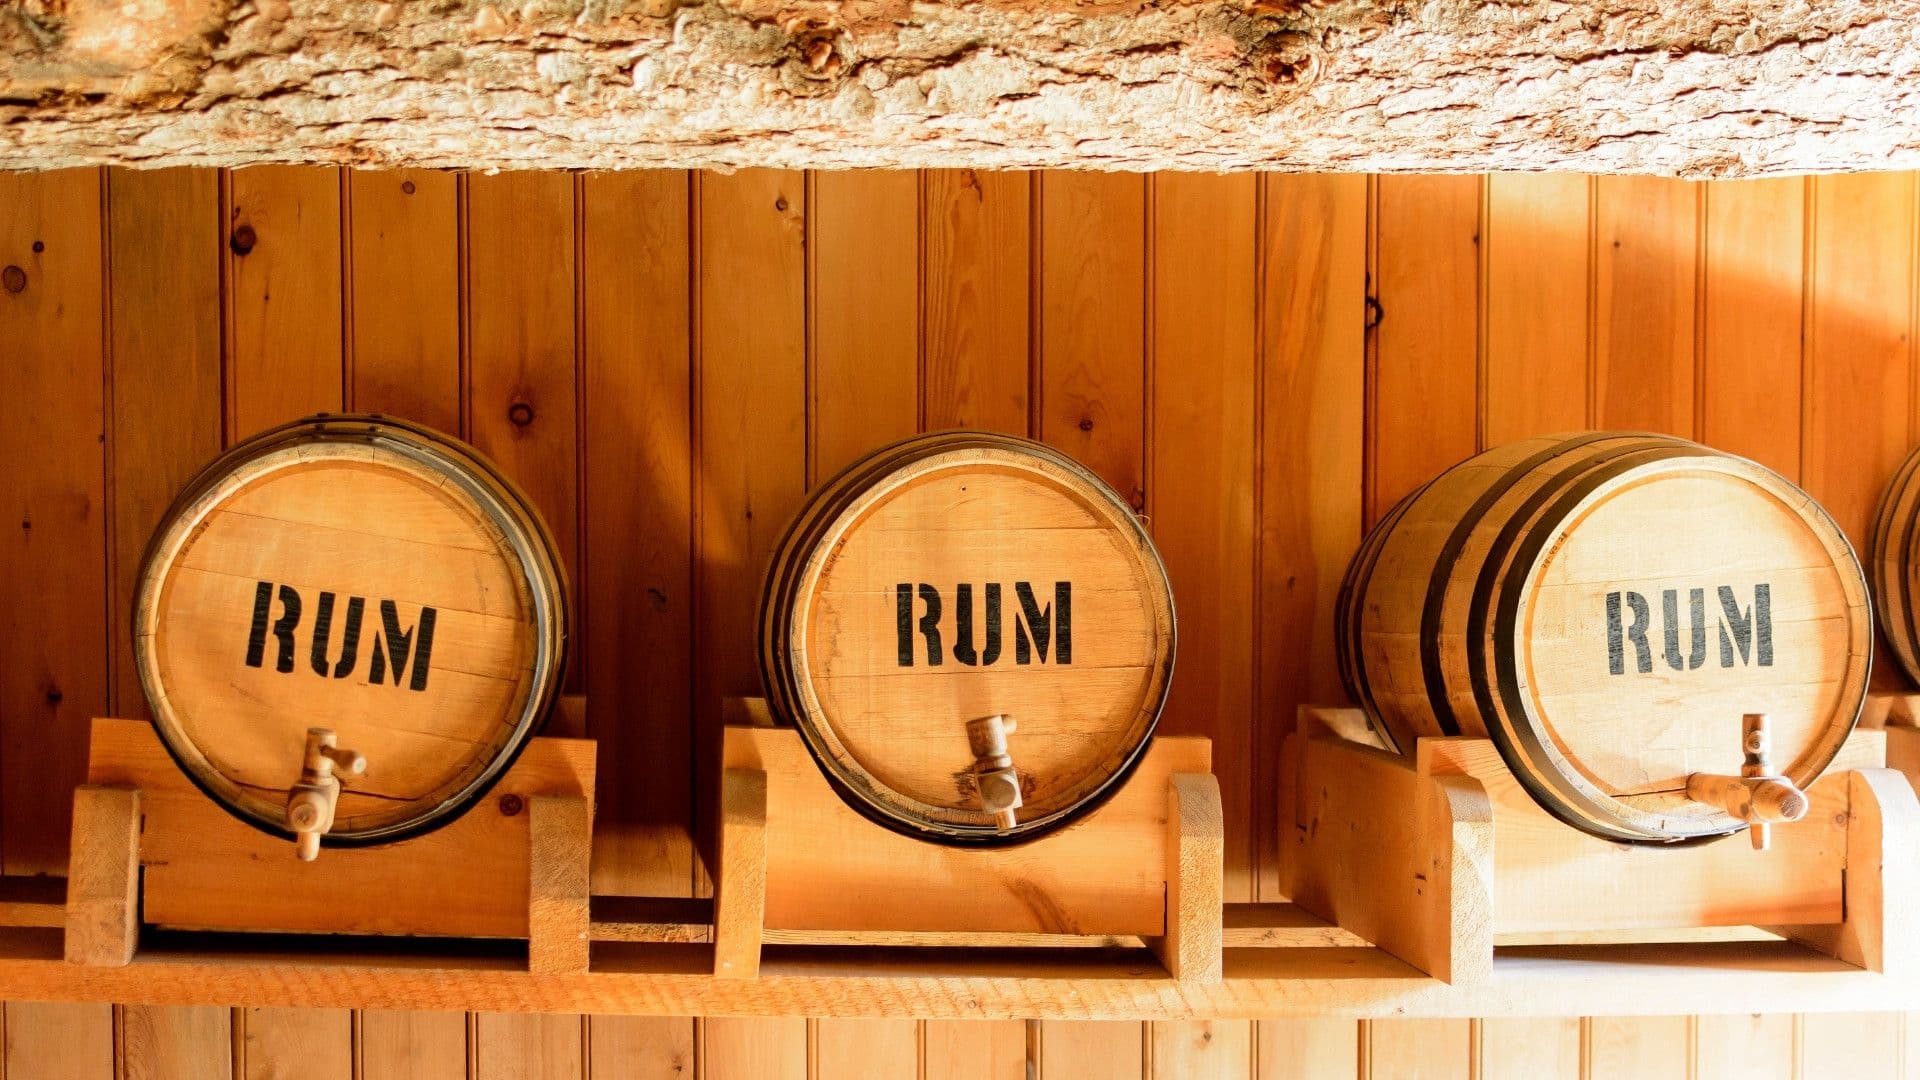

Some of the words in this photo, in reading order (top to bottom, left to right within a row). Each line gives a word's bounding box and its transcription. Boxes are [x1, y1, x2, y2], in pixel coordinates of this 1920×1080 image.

[245, 581, 437, 692] RUM
[896, 581, 1073, 667] RUM
[1606, 583, 1773, 675] RUM
